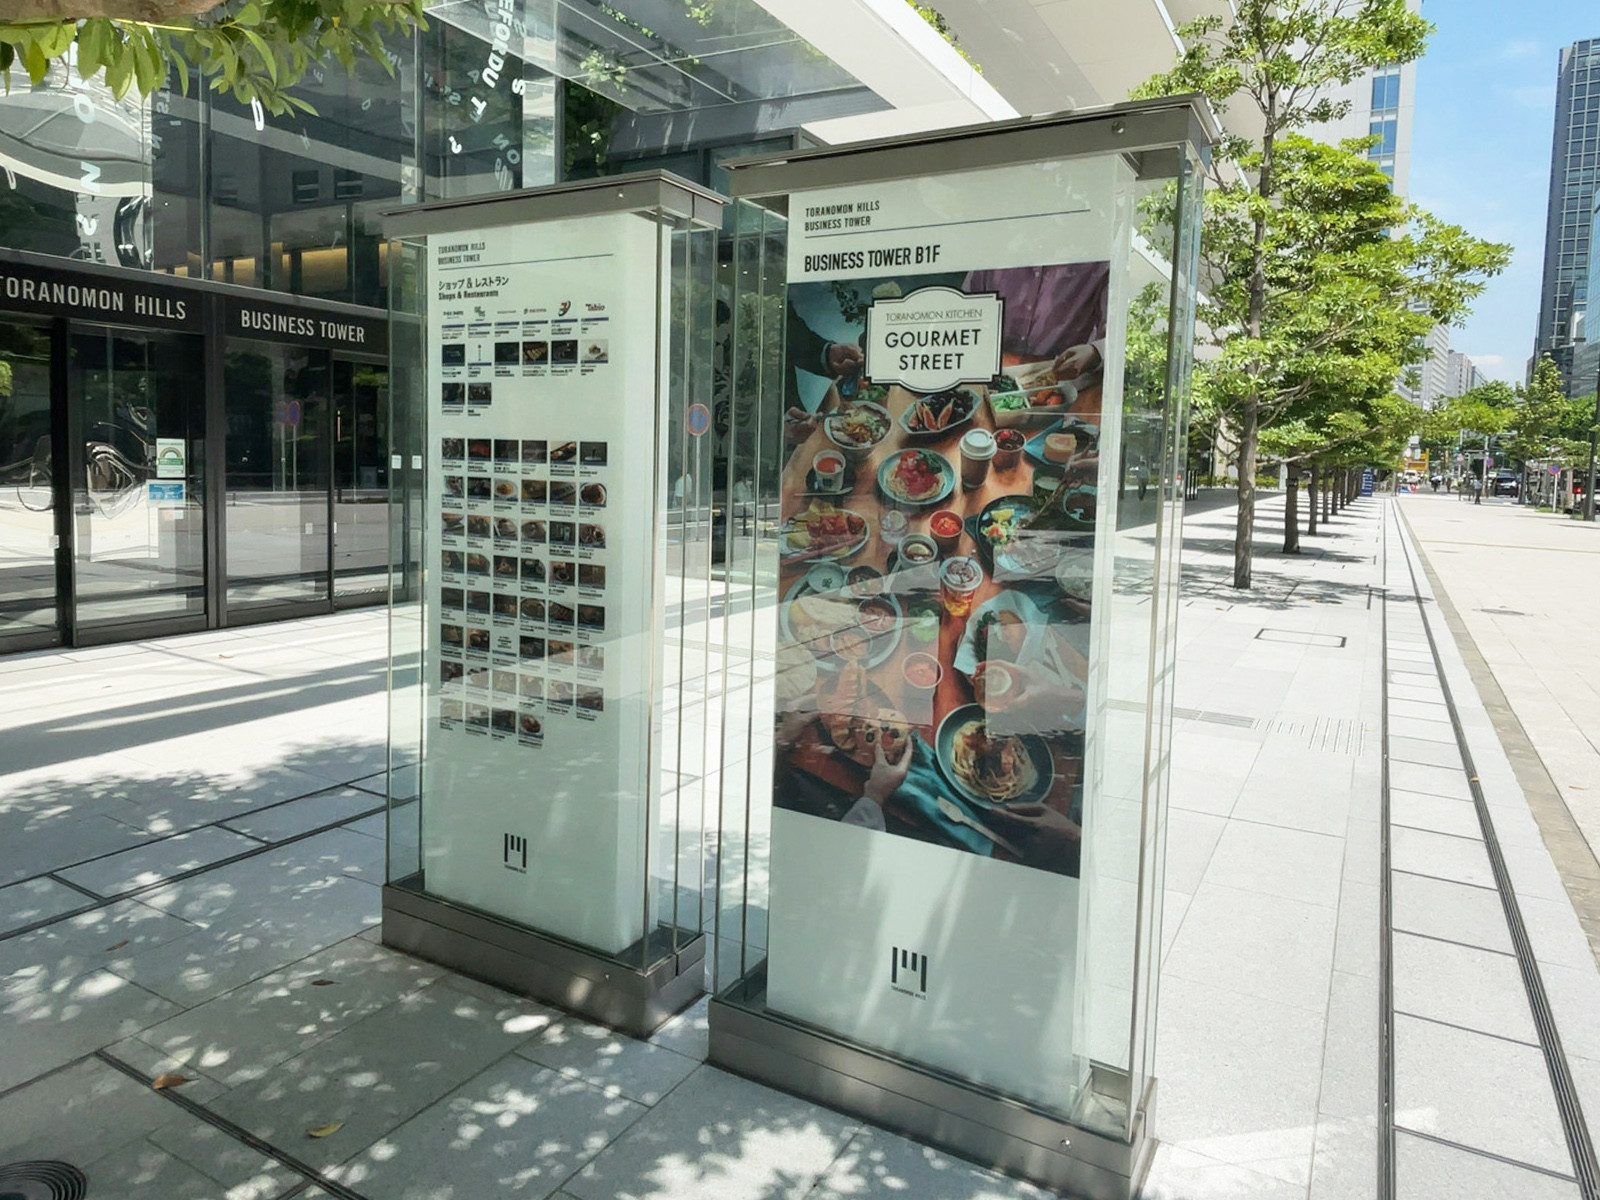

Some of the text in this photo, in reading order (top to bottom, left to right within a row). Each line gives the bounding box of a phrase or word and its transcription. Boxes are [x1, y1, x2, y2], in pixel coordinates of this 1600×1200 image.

[805, 200, 880, 218] TORANOMON HILLS
[804, 216, 872, 232] BUSINESS TOWER
[804, 244, 941, 273] BUSINESS TOWER B1F
[438, 279, 465, 291] ショップ
[475, 276, 509, 288] レストラン
[135, 295, 187, 320] HILLS
[885, 308, 983, 321] TORANOMON KITCHEN
[241, 310, 365, 343] BUSINESS TOWER
[885, 328, 982, 348] GOURMET
[899, 353, 964, 371] STREET
